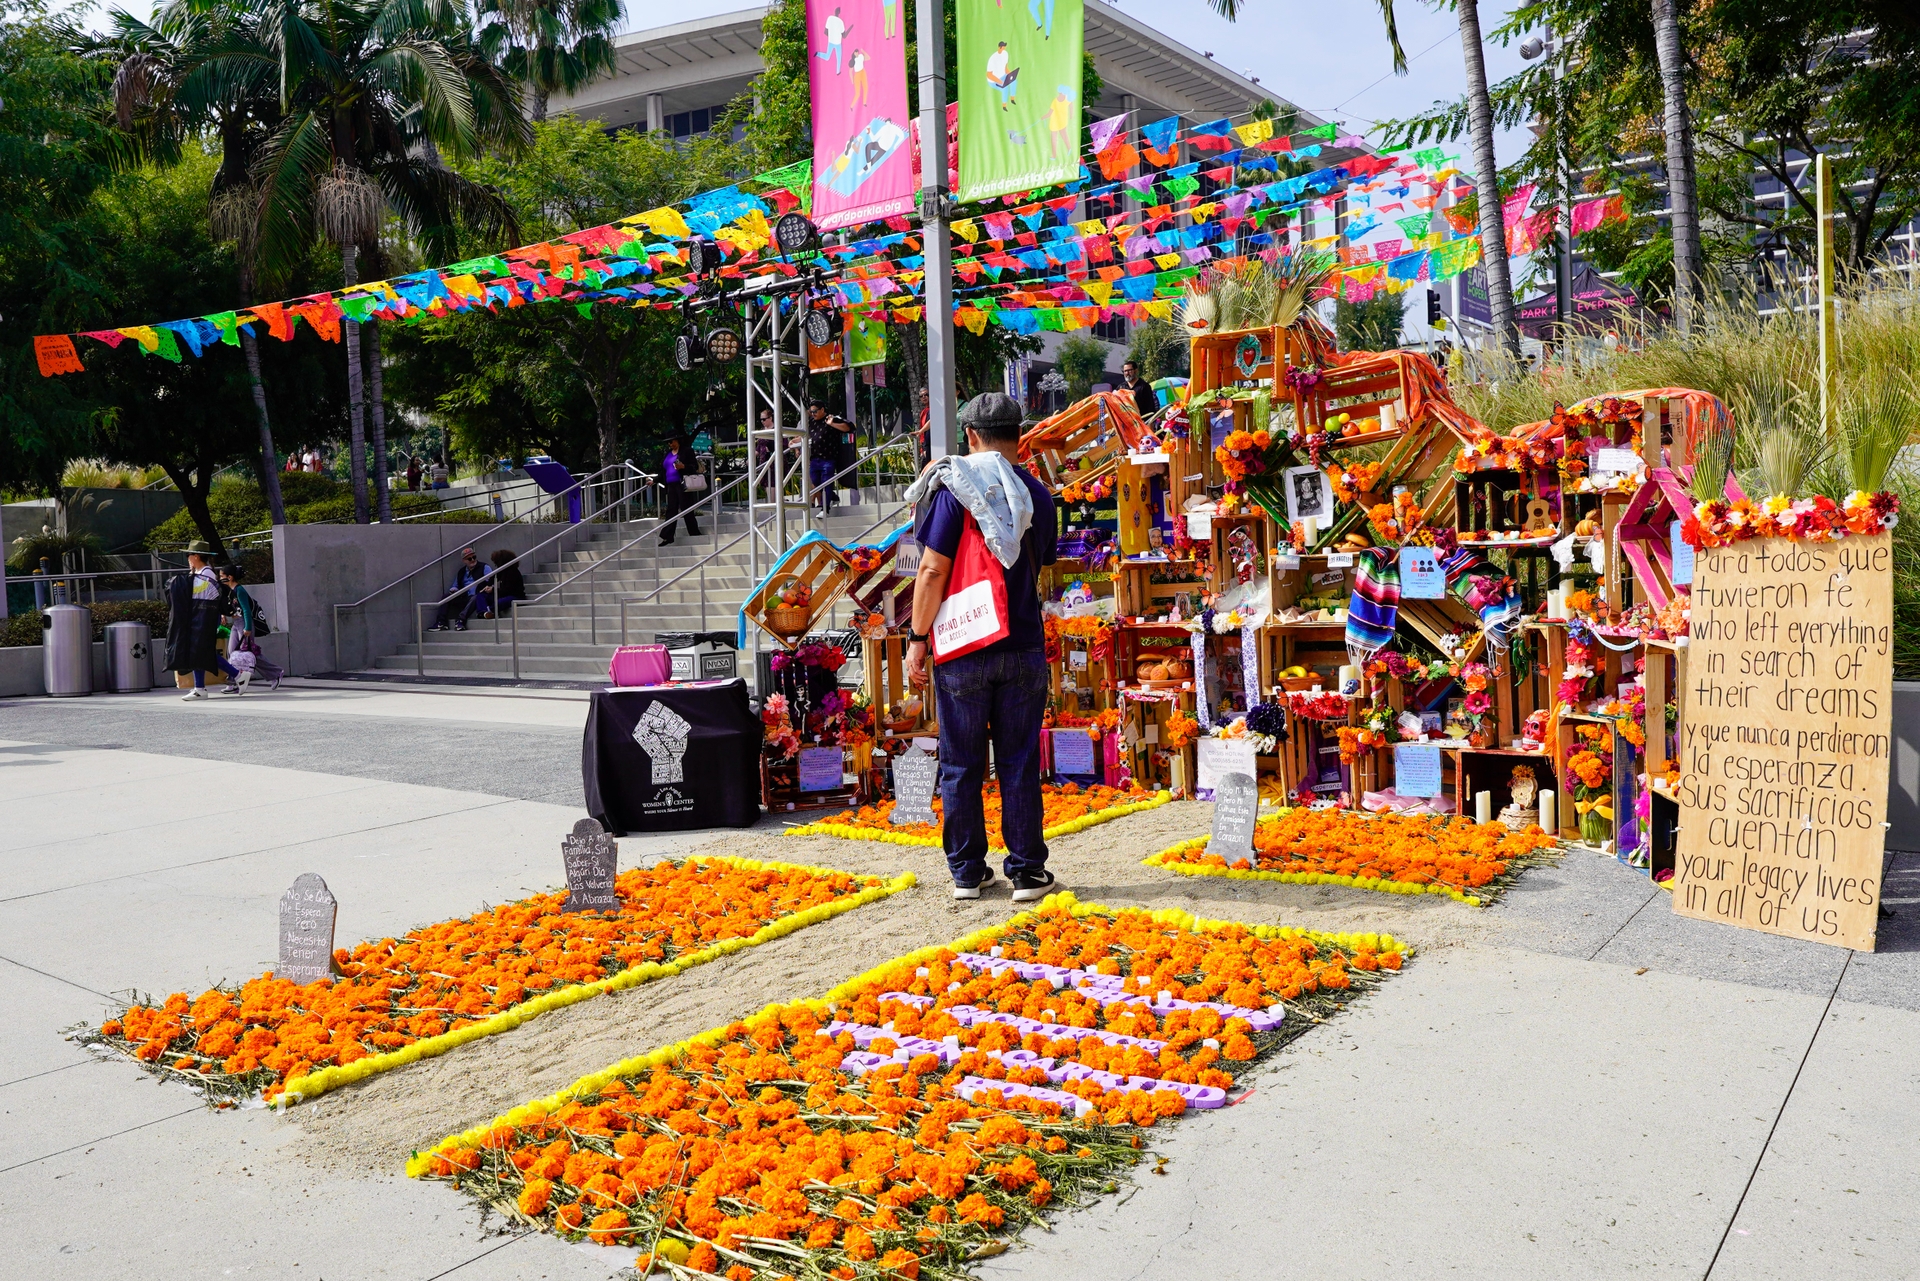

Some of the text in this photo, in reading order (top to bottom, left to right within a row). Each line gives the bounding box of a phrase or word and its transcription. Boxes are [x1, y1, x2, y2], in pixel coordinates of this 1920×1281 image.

[971, 168, 1064, 197] grandparkla.org
[821, 202, 901, 228] grandparkla.org
[1521, 307, 1547, 319] PARK
[1695, 546, 1748, 573] Para
[1755, 543, 1826, 572] todos
[1839, 547, 1888, 575] que
[1696, 576, 1808, 608] tuvieron
[938, 618, 958, 635] GRAND
[973, 604, 989, 620] ARTS
[949, 628, 967, 641] ACCESS
[1693, 609, 1888, 655] who left everything
[1707, 643, 1867, 681] in search of
[1695, 678, 1878, 719] their dreams
[1686, 722, 1889, 759] y que nunca perdieron
[902, 755, 927, 765] Aunque
[895, 770, 920, 780] Riesgos
[1692, 746, 1866, 791] la esperanza.
[1219, 784, 1233, 796] Dejo
[1235, 786, 1241, 794] Mi
[899, 794, 930, 804] Peligroso
[1682, 774, 1872, 829] Sus sacrificios
[900, 804, 931, 813] Quedarme
[893, 813, 903, 823] En
[906, 814, 913, 822] Mi
[1219, 822, 1226, 831] En
[569, 836, 586, 846] Dejo
[597, 834, 606, 844] Mi
[1709, 817, 1836, 862] cuentan
[594, 844, 609, 855] Sin
[569, 881, 584, 890] Los
[1681, 853, 1874, 906] your legacy lives
[286, 889, 332, 903] No Se Que
[571, 893, 614, 904] A Abrazar
[281, 901, 291, 914] Me
[1686, 881, 1845, 936] in all of us.
[295, 917, 317, 929] Pero
[287, 932, 327, 946] Necesito
[287, 947, 318, 959] Tener
[281, 960, 328, 977] Esperanza
